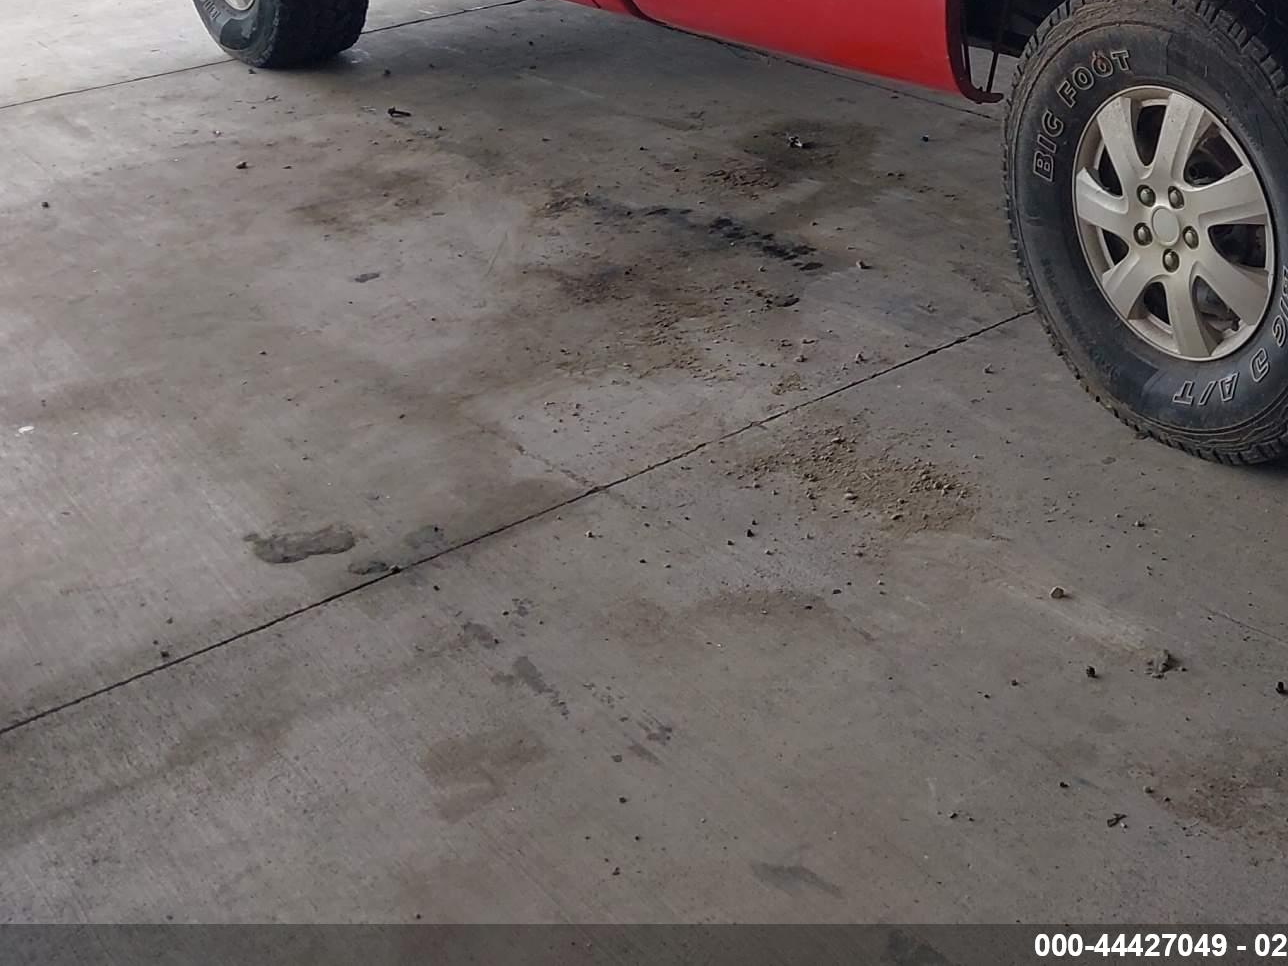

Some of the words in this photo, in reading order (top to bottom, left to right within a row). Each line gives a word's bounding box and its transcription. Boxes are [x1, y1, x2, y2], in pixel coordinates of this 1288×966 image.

[1032, 109, 1065, 183] BIG
[1056, 49, 1130, 109] FOOT
[1172, 371, 1240, 406] A/T
